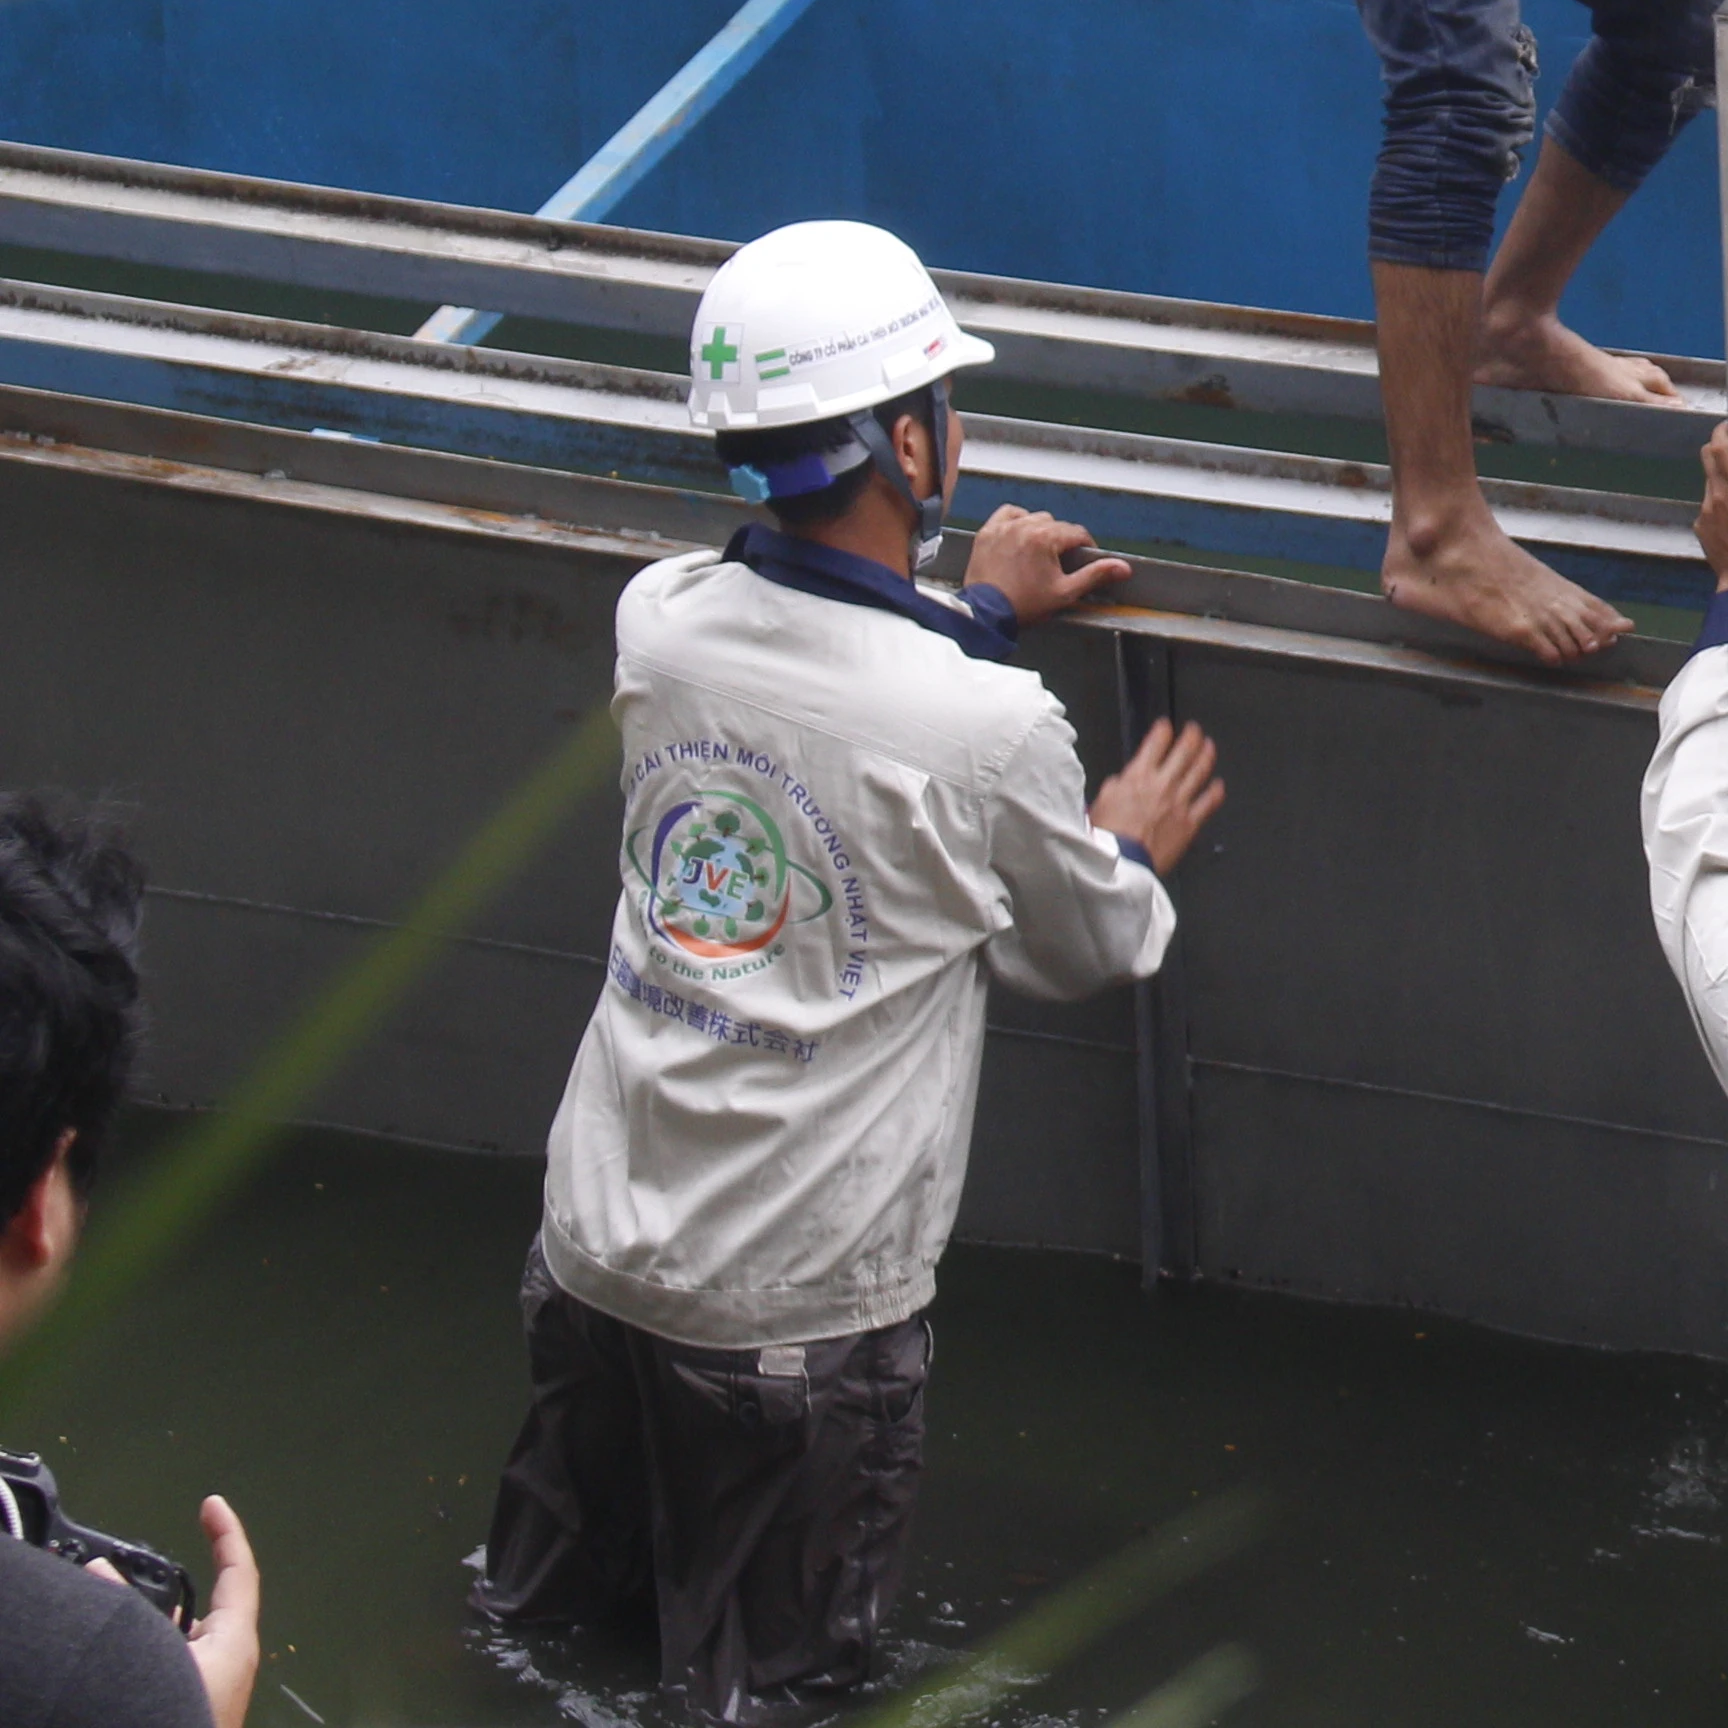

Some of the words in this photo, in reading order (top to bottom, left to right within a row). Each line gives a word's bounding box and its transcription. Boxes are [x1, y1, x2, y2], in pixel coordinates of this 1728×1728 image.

[736, 747, 777, 779] MÔI
[682, 858, 749, 900] JVE
[649, 946, 667, 964] to
[672, 959, 704, 980] the
[711, 942, 786, 981] Nature
